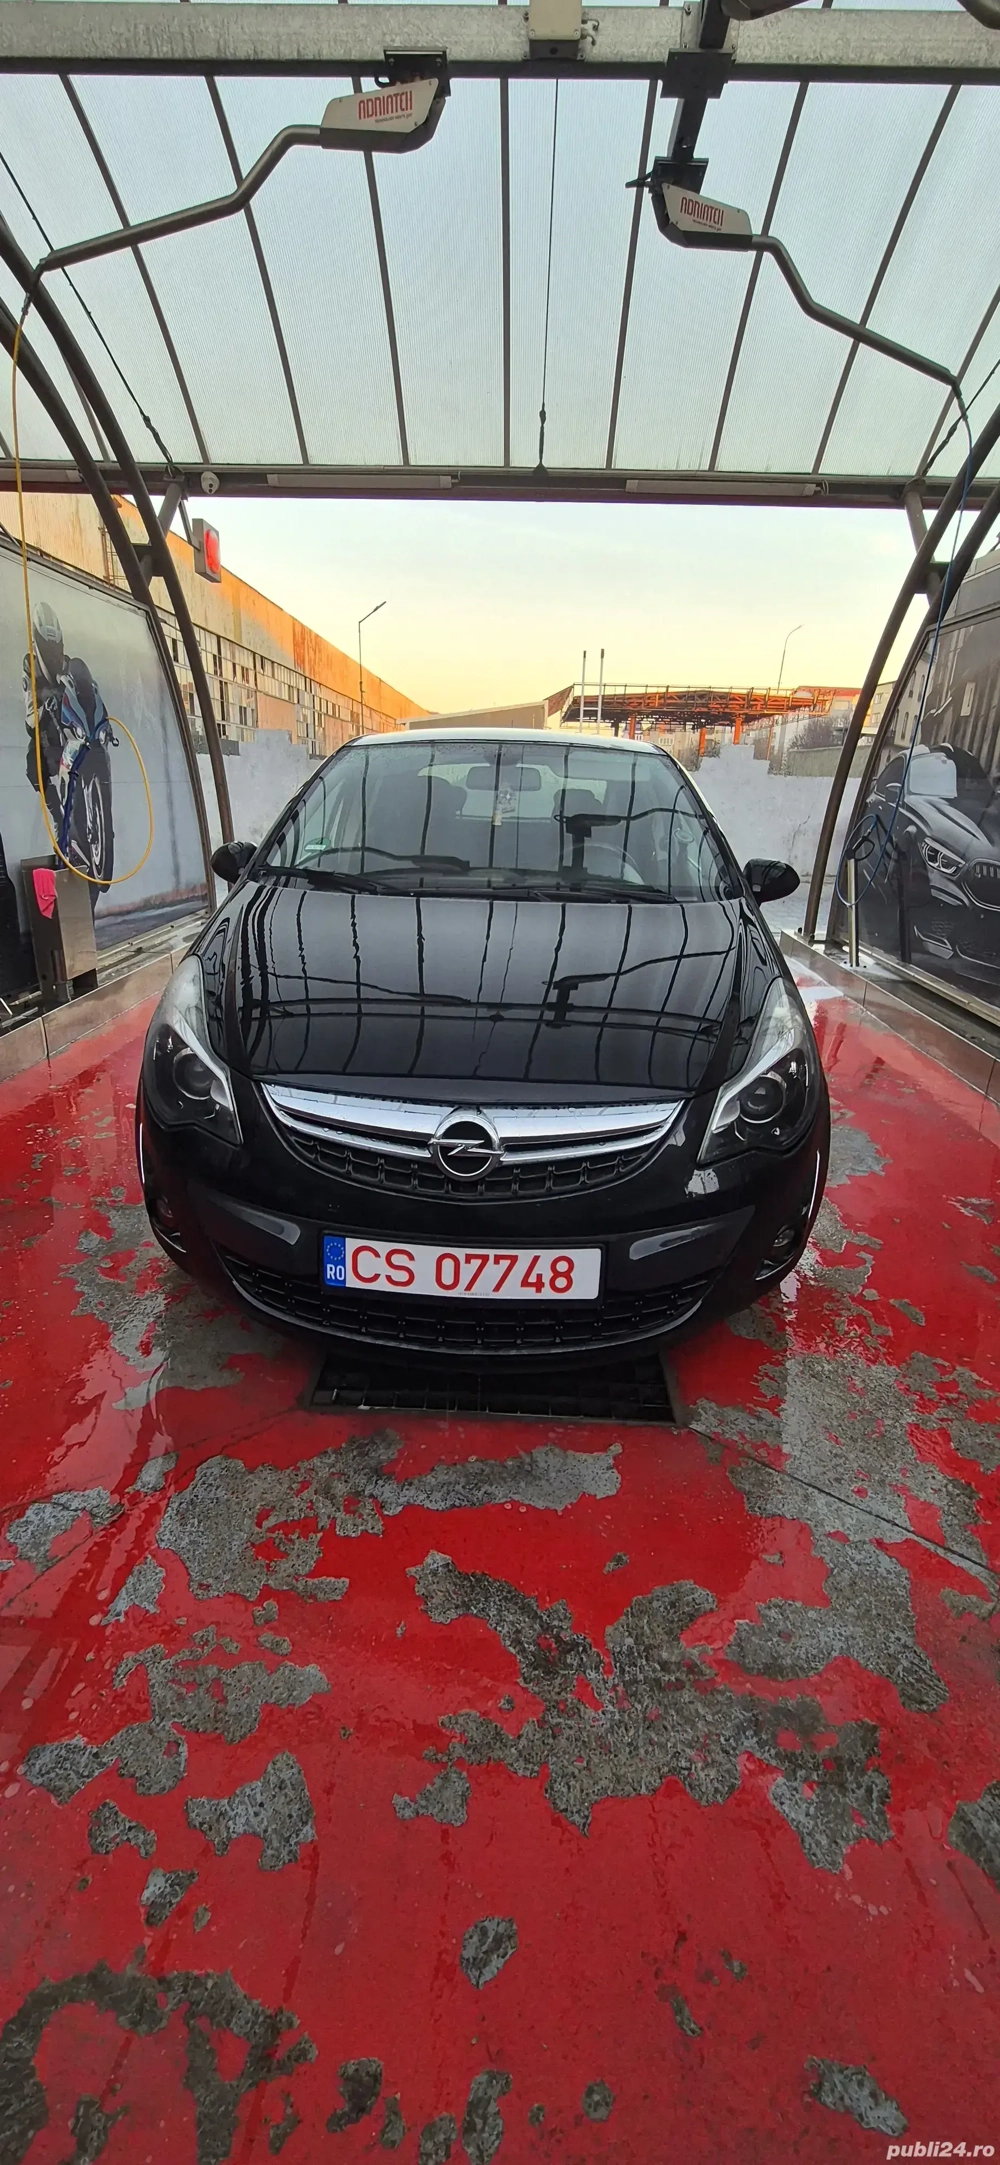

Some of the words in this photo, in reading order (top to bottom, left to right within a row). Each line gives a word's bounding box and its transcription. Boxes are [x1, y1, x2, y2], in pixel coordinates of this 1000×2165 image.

[326, 1263, 345, 1281] RO
[351, 1245, 415, 1287] CS
[435, 1252, 575, 1294] 07748
